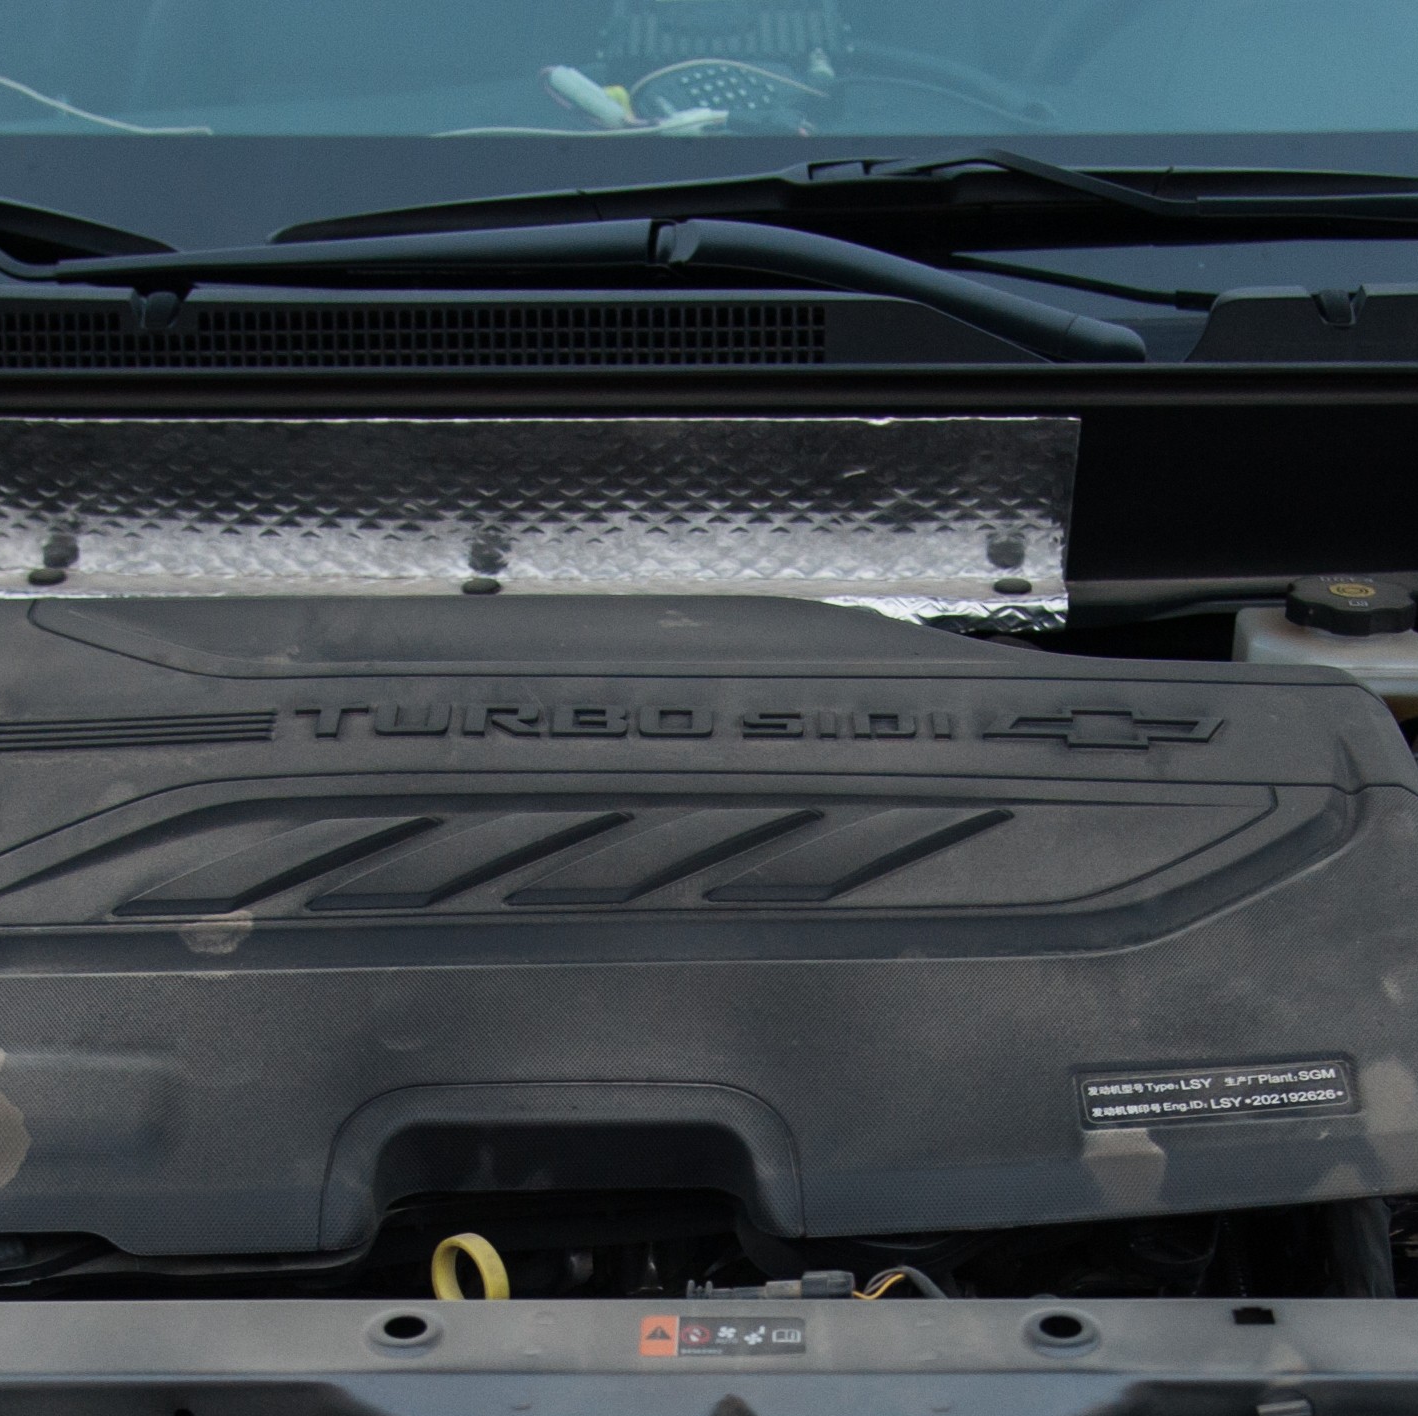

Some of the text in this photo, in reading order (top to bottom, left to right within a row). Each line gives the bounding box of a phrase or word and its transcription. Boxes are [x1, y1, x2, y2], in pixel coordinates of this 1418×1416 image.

[294, 703, 954, 741] TURBO SIDI
[1180, 1077, 1212, 1091] LSY
[1298, 1068, 1336, 1081] SGM
[1210, 1097, 1242, 1110] LSY
